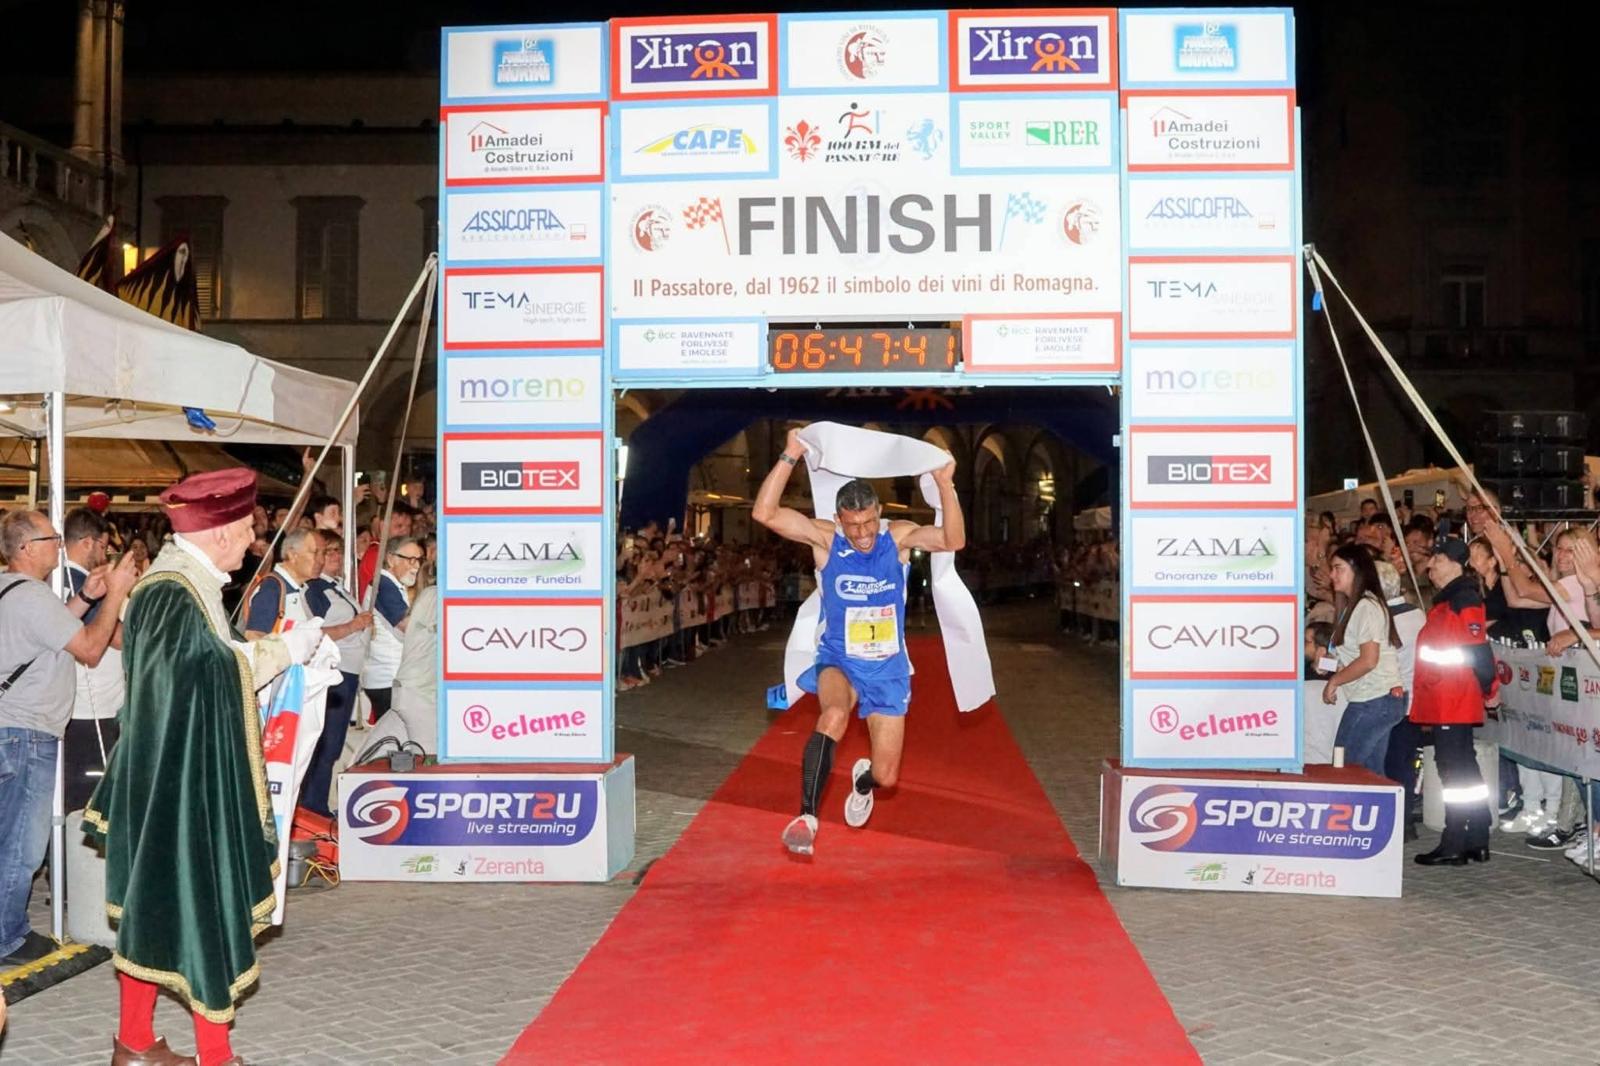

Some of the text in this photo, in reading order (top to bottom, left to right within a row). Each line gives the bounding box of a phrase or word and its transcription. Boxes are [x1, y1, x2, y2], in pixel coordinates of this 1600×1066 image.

[634, 37, 754, 72] Kiron
[973, 29, 1095, 64] Kiron
[969, 121, 1011, 130] SPORT
[1168, 120, 1229, 133] Amadei
[485, 133, 543, 147] Amadei
[673, 129, 743, 150] CAPE
[969, 131, 1011, 140] VALLEY
[1168, 136, 1261, 150] Costruzioni
[827, 141, 852, 151] 100
[485, 149, 574, 164] Costruzioni
[1146, 196, 1254, 220] ASSICOFRA
[462, 209, 566, 232] ASSICOFRA
[738, 194, 992, 256] FINISH
[651, 278, 738, 298] Passatore,
[746, 277, 772, 296] dal
[779, 277, 820, 295] 1962
[827, 275, 838, 295] il
[844, 274, 911, 294] simbolo
[918, 274, 944, 293] dei
[952, 273, 982, 292] vini
[989, 273, 1006, 292] di
[1013, 273, 1099, 296] Romagna.
[1147, 281, 1218, 298] TEMA
[462, 292, 530, 309] TEMA
[524, 301, 587, 315] SINERGIE
[680, 331, 735, 339] RAVENNATE
[680, 340, 729, 348] FORLIVESE
[688, 348, 728, 357] IMOLESE
[775, 332, 955, 370] 06:47:41
[460, 377, 586, 399] moreno
[1145, 368, 1275, 390] moreno
[480, 468, 578, 488] BIOTEX
[1167, 463, 1269, 481] BIOTEX
[469, 542, 583, 561] ZAMA
[1157, 537, 1275, 557] ZAMA
[467, 575, 582, 585] Onoranze Funebri
[1154, 571, 1275, 581] Onoranze Funebri
[461, 627, 588, 652] CAVIRO
[869, 625, 876, 641] 1
[1148, 624, 1280, 650] CAVIRO
[413, 792, 582, 820] SPORT2U
[1201, 799, 1380, 832] SPORT2U
[467, 822, 577, 837] live streaming
[1257, 830, 1372, 850] live streaming
[474, 857, 545, 876] Zeranta
[1262, 867, 1337, 889] Zeranta
